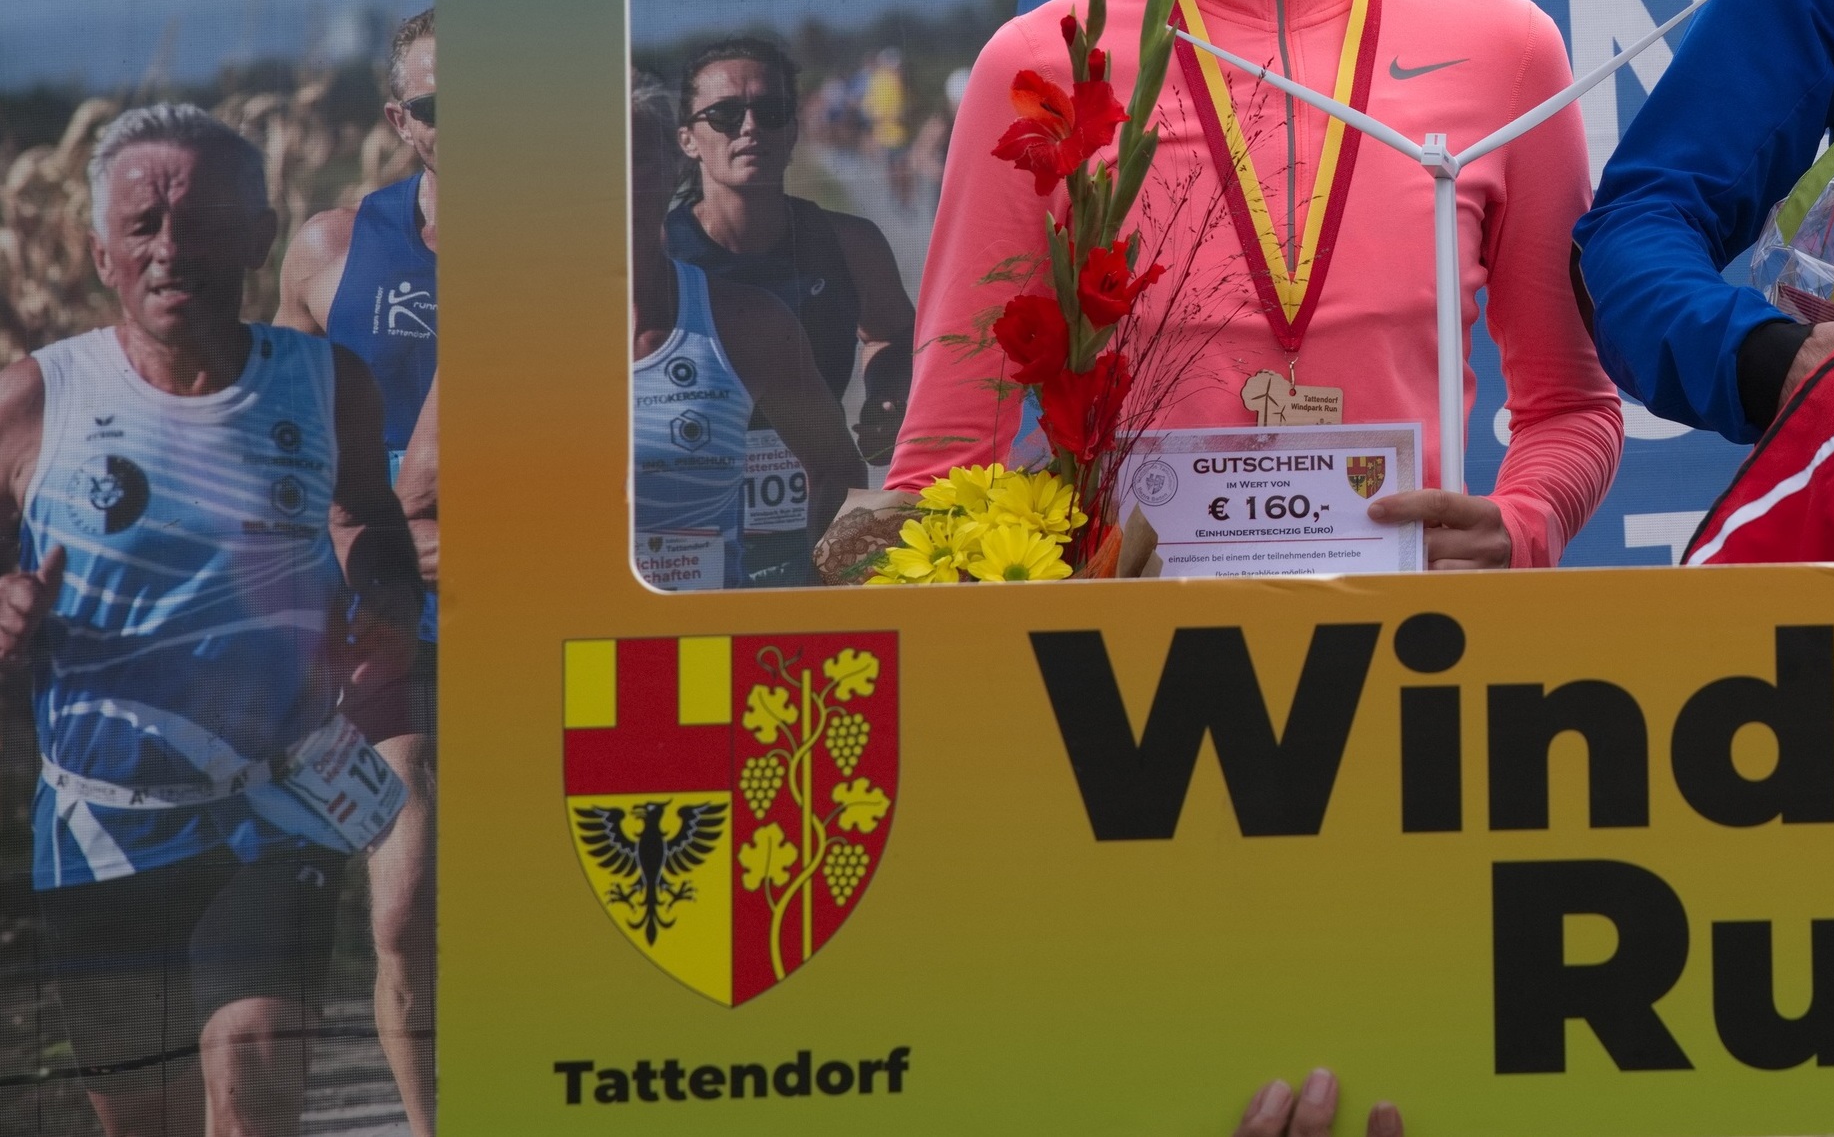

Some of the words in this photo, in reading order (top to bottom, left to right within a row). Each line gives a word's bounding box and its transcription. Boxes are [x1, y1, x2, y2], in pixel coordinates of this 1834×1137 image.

[413, 301, 438, 311] runn
[1291, 403, 1323, 412] Windpark
[1304, 395, 1338, 403] Tattendorf
[1193, 454, 1334, 474] GUTSCHEIN
[744, 472, 808, 509] 109
[1208, 496, 1230, 521] €
[1246, 494, 1330, 523] 160,-
[1168, 554, 1210, 563] einzulösen
[1212, 553, 1224, 562] bei
[1226, 553, 1250, 562] einem
[1252, 552, 1265, 561] der
[1267, 551, 1326, 560] teilnehmenden
[1328, 549, 1361, 558] Betriebe
[554, 1046, 911, 1105] Tattendorf
